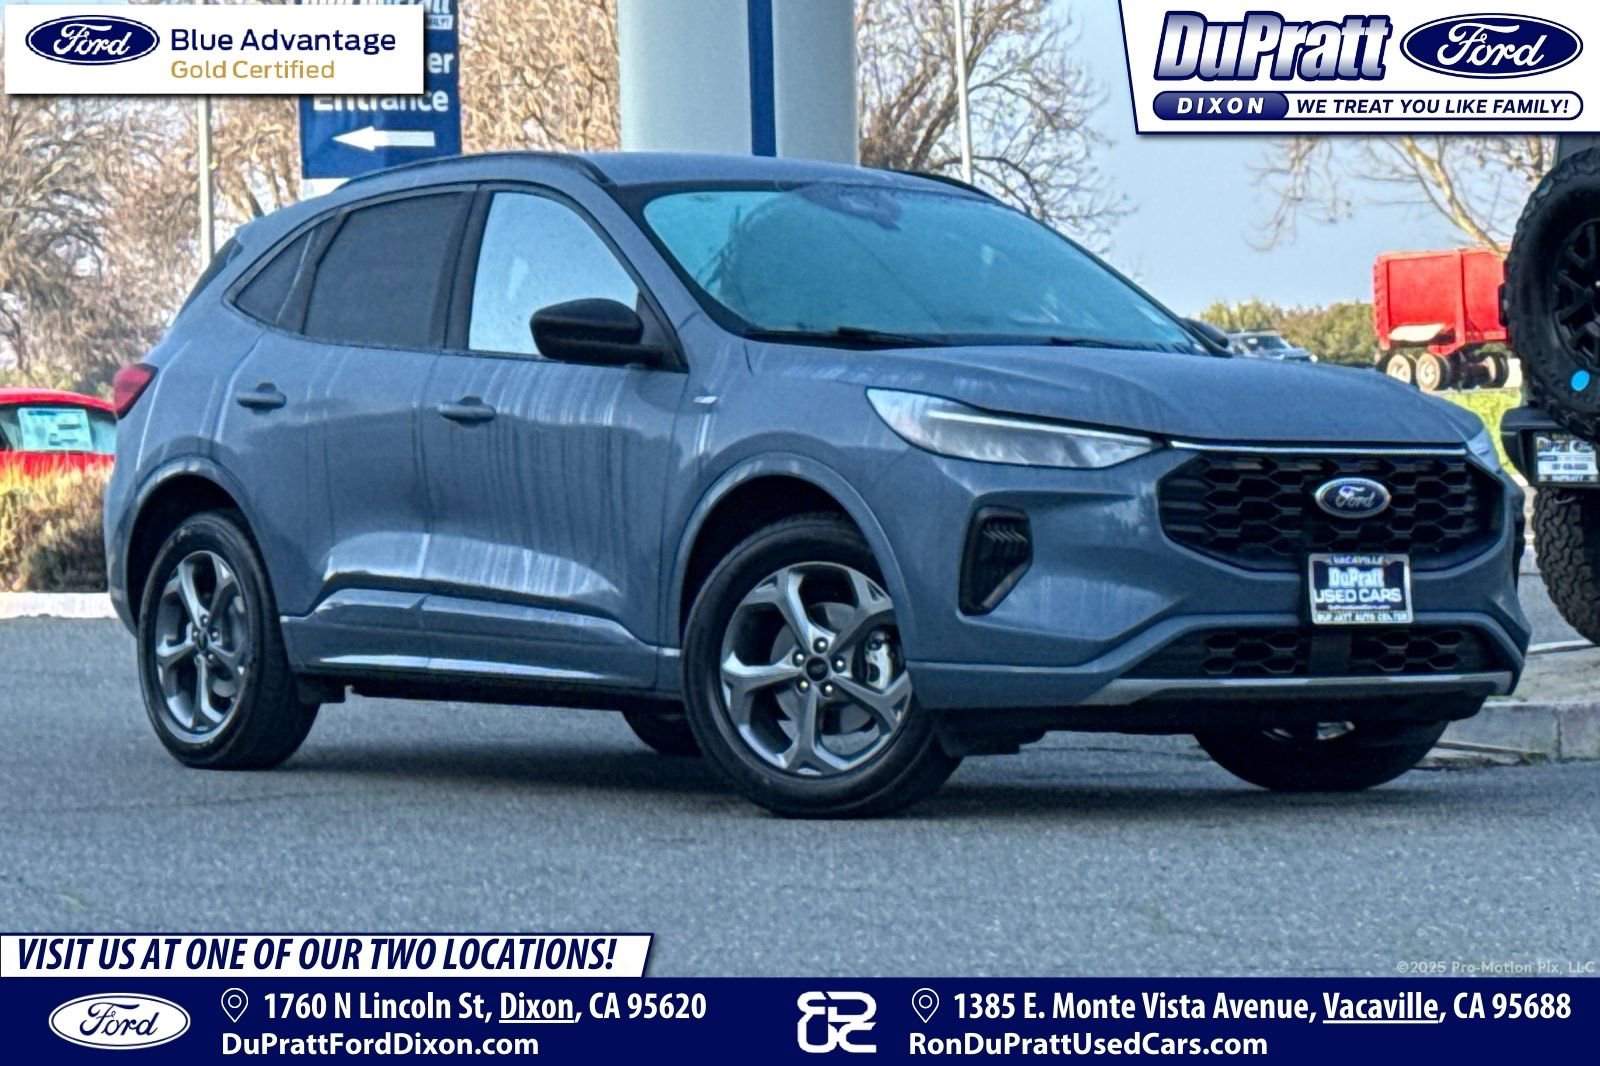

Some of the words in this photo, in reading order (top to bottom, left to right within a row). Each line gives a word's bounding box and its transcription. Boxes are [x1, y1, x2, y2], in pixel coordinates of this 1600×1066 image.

[1335, 485, 1376, 508] Ford
[1314, 588, 1357, 603] USED
[1359, 587, 1402, 603] CARS
